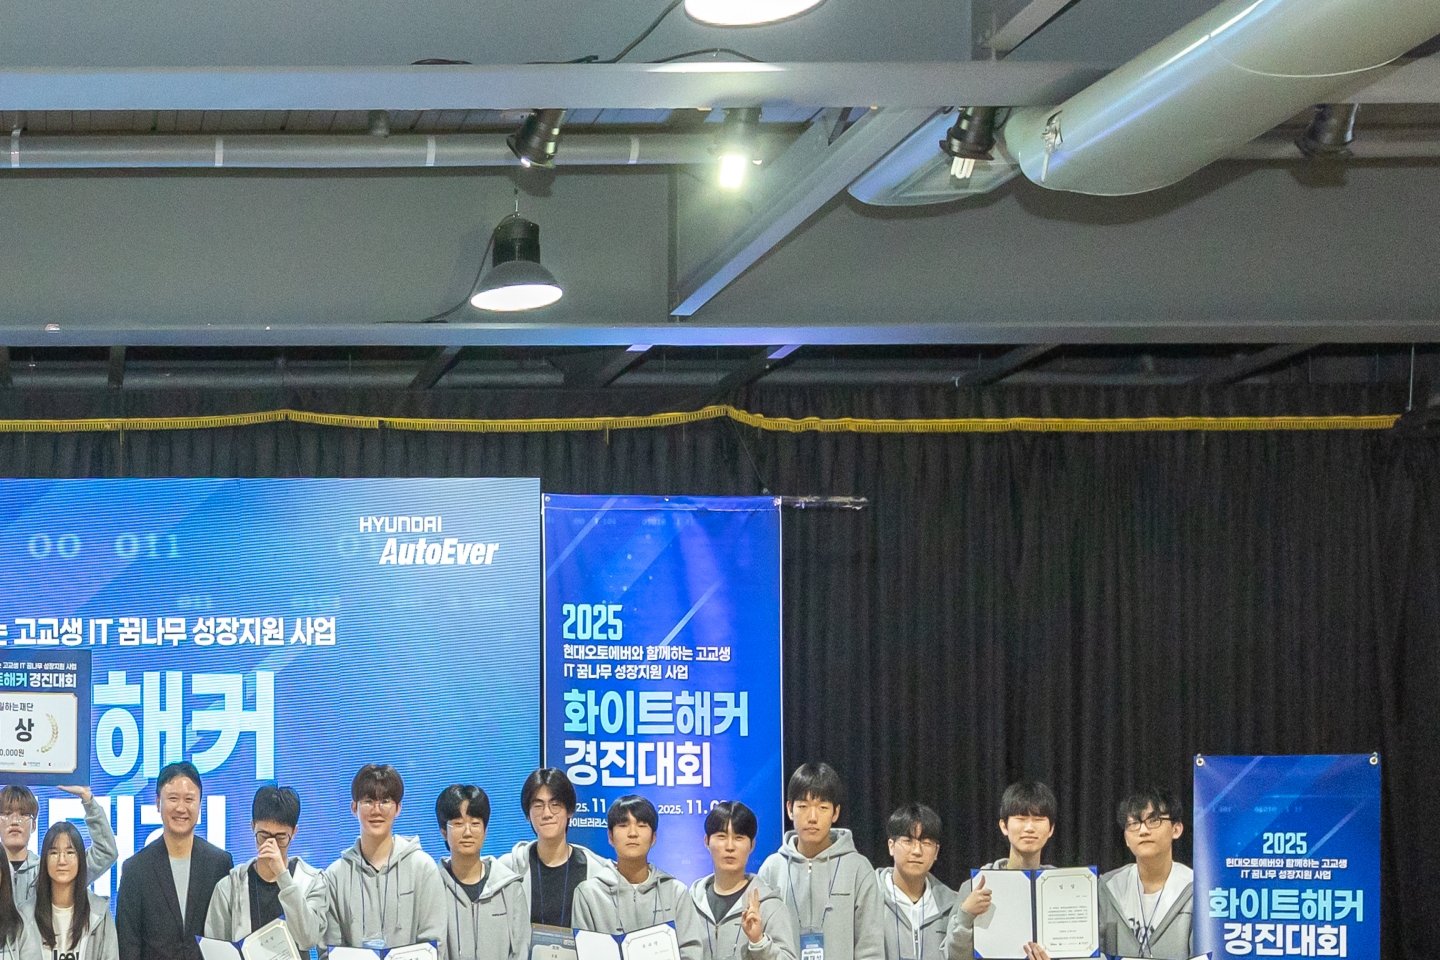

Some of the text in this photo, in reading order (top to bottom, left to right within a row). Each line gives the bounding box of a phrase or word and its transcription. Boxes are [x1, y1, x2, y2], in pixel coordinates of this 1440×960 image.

[359, 516, 442, 533] HYUNDAI
[379, 537, 499, 566] AutoEver
[14, 617, 83, 647] 고교생
[89, 618, 114, 646] IT
[118, 617, 187, 646] 꿈나무
[192, 616, 285, 647] 성장지원
[290, 616, 337, 647] 사업
[562, 604, 623, 640] 2025
[563, 645, 730, 661] 현대오토에버와 함께하는 고교생
[30, 673, 77, 688] 경진대회
[564, 665, 688, 679] IT 꿈나무 성장지원 사업
[563, 689, 748, 736] 화이트해커
[564, 740, 711, 787] 경진대회
[658, 805, 684, 814] 2025.
[1263, 832, 1307, 854] 2025
[1321, 859, 1347, 868] 고교생
[1241, 870, 1250, 878] IT
[1314, 871, 1331, 880] 사업
[1209, 888, 1363, 922] 화이트해커
[1224, 923, 1347, 958] 경진대회
